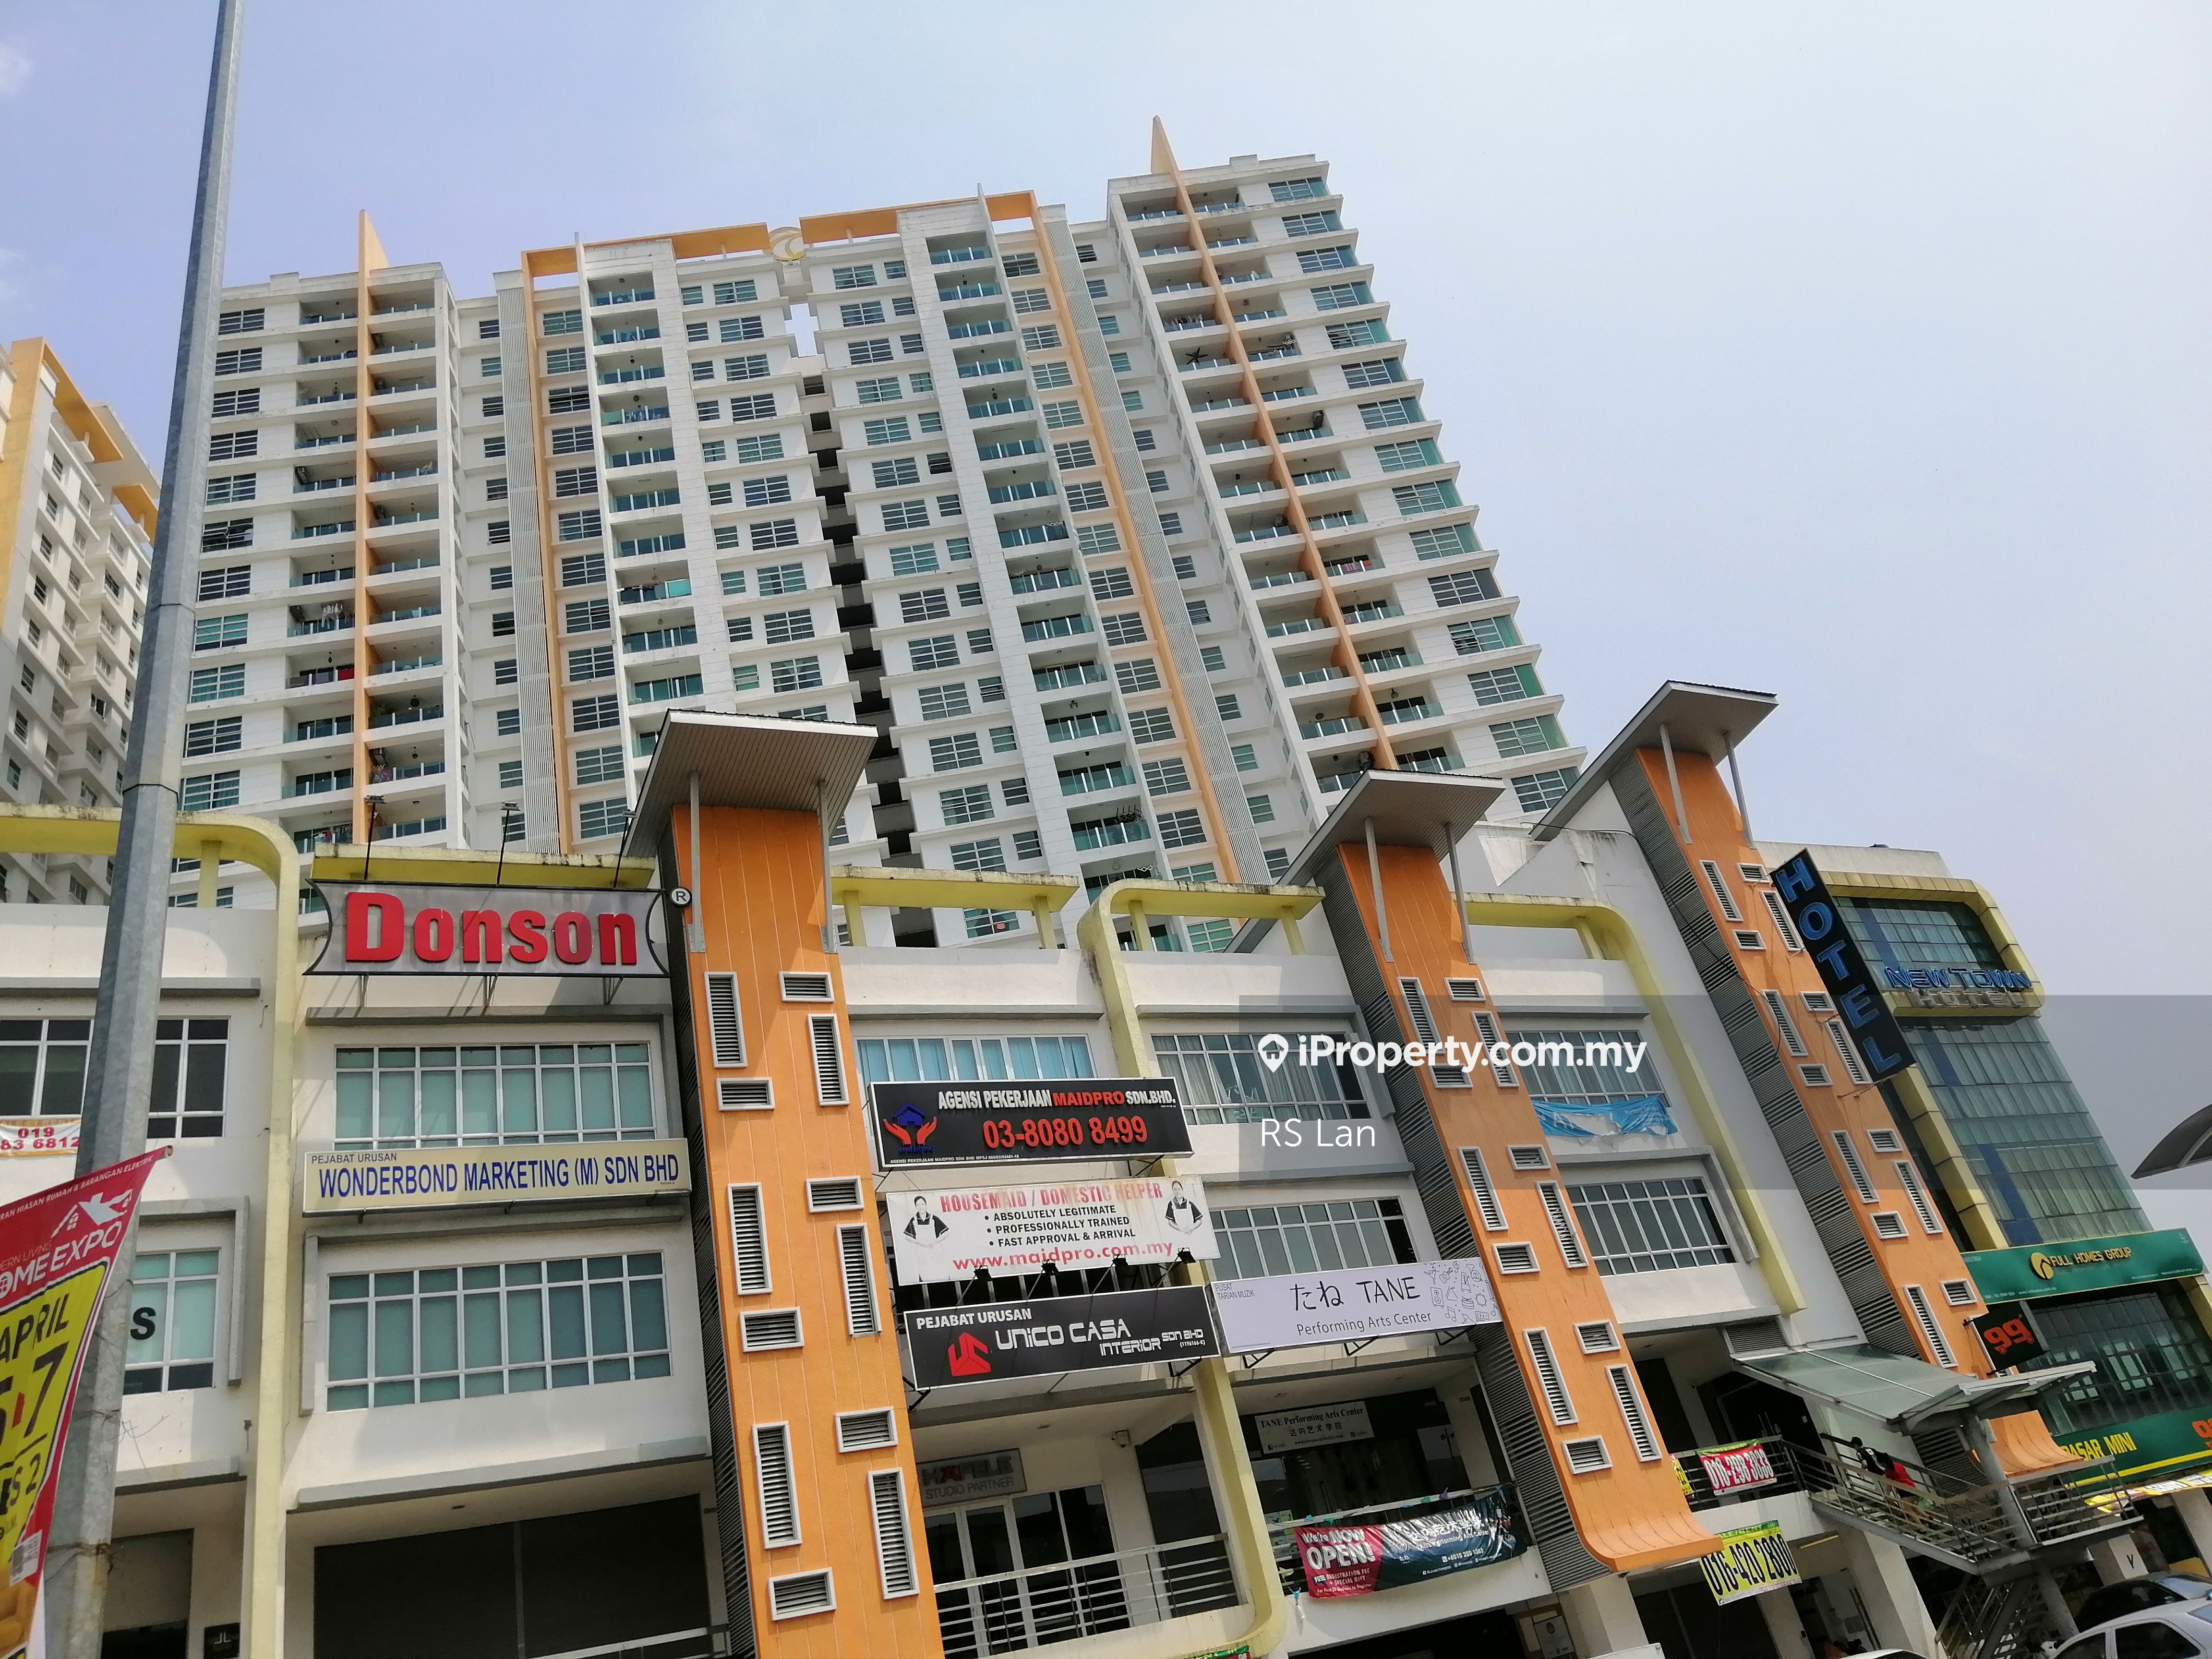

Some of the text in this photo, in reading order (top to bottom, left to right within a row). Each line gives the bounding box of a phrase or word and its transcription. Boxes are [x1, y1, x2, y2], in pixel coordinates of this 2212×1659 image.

[346, 891, 637, 965] Donson
[1776, 856, 1902, 1074] HOTEL
[938, 1090, 983, 1109] AGENSI
[983, 1089, 1052, 1108] PEKERJAAN
[1052, 1091, 1125, 1106] MAIDPRO
[18, 1127, 54, 1138] 019
[33, 1137, 79, 1149] 6812
[983, 1115, 1148, 1149] 03-8080 8499
[312, 1153, 397, 1164] PEJABAT URUSAN
[17, 1197, 45, 1214] HIASAN
[46, 1187, 73, 1202] RUMAH
[81, 1167, 122, 1189] BARANGAN
[124, 1155, 154, 1173] ELEKTRIK
[319, 1154, 678, 1198] WONDERBOND MARKETING (M) SDN BHD
[940, 1190, 1027, 1213] HOUSEMAID
[1040, 1185, 1111, 1206] DOMESTIC
[1115, 1182, 1163, 1201] HELPER
[994, 1205, 1116, 1221] ABSOLUTELY LEGITIMATE
[996, 1216, 1130, 1234] PROFESSIONALLY TRAINED
[998, 1237, 1022, 1247] FAST
[1026, 1233, 1080, 1245] APPROVAL
[1094, 1229, 1136, 1239] ARRIVAL
[952, 1242, 1172, 1270] www.maidpro.com.my
[2050, 1247, 2131, 1267] FULL HOMES GROUP
[1215, 1283, 1233, 1291] PUSAT
[1217, 1289, 1255, 1300] TARIAN MUZIK
[1290, 1281, 1344, 1311] たね
[1356, 1277, 1420, 1304] TANE
[0, 1293, 69, 1363] APRIL
[916, 1308, 1032, 1330] PEJABAT URUSAN
[1297, 1312, 1431, 1336] Performing Arts Center
[1069, 1319, 1132, 1343] CASA
[1161, 1331, 1182, 1342] SDN
[1183, 1329, 1204, 1339] BHD
[1260, 1418, 1283, 1428] TANE
[1284, 1413, 1324, 1425] Performing
[1340, 1408, 1363, 1416] Center
[2104, 1432, 2137, 1455] MINI
[926, 1477, 1014, 1499] STUDIO PARTNER
[1301, 1528, 1365, 1543] We're NOW
[1306, 1542, 1376, 1570] OPEN!
[1701, 1533, 1797, 1596] 016-420 2800
[1314, 1575, 1326, 1583] FREE
[1326, 1570, 1360, 1579] REGISTRATION
[1334, 1577, 1353, 1585] SPECIAL
